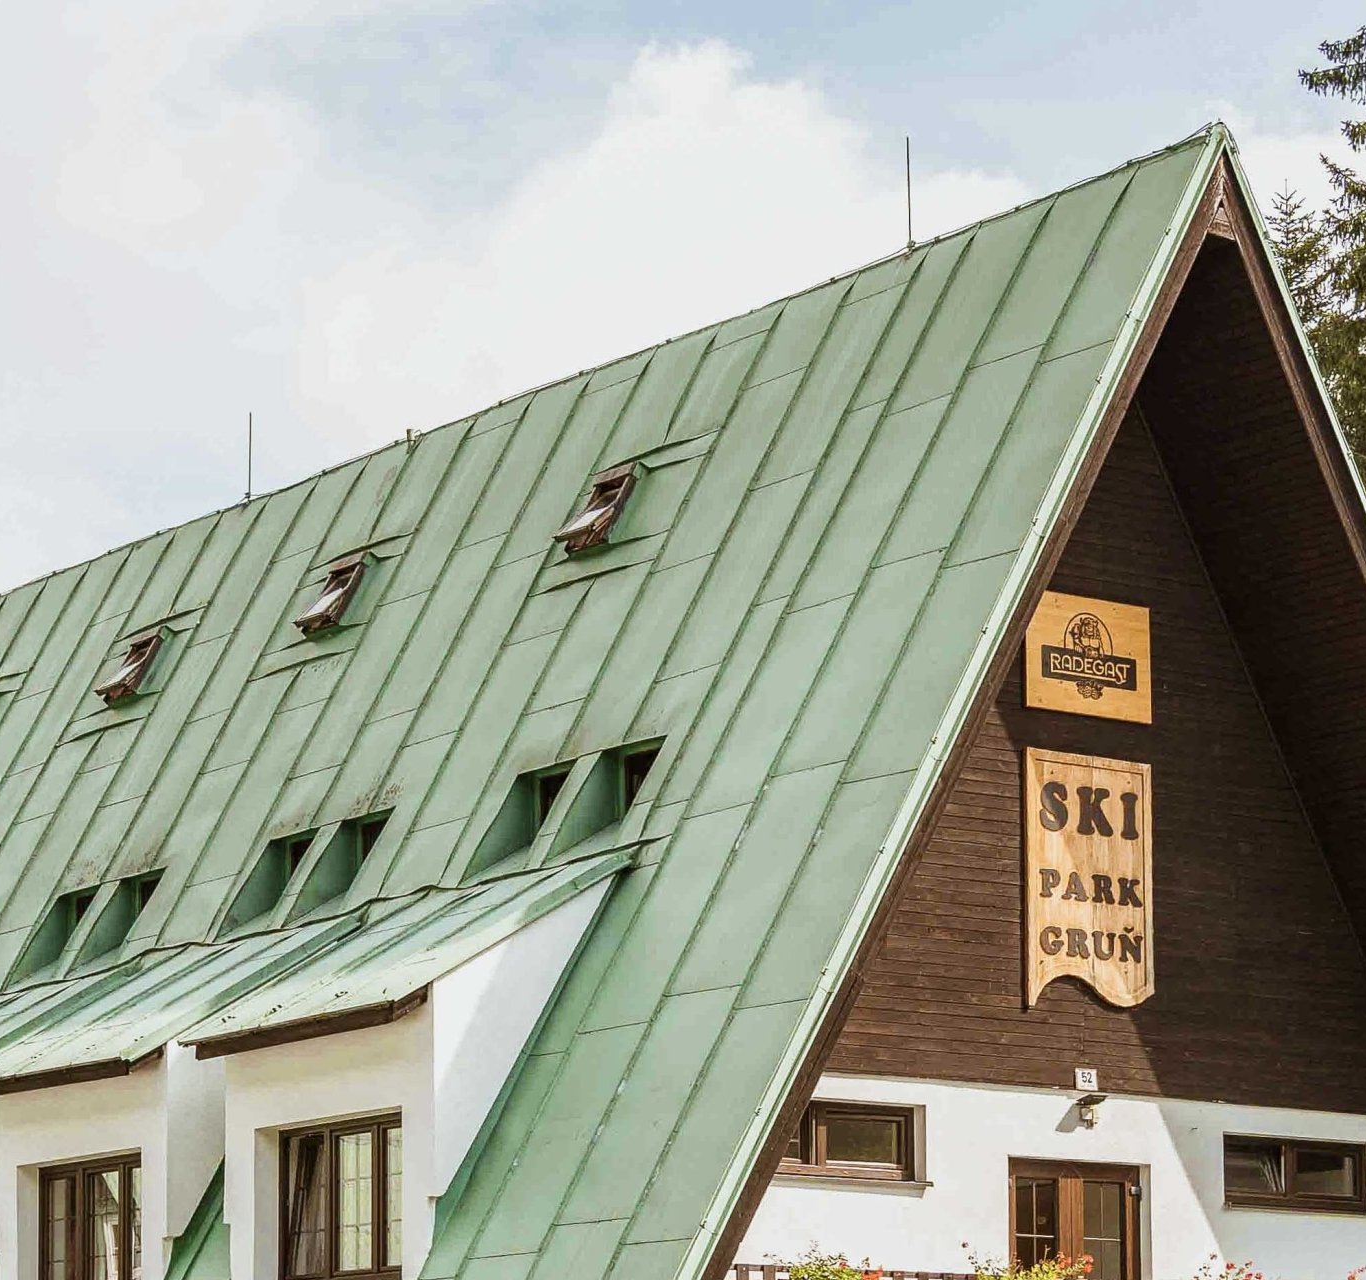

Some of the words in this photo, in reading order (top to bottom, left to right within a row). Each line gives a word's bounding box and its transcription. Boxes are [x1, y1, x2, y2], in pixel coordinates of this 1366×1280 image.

[1050, 653, 1131, 684] RADEGAST
[1039, 781, 1139, 841] SKI
[1039, 868, 1143, 908] PARK
[1039, 926, 1144, 963] GRUŇ
[1081, 1071, 1093, 1084] 52
